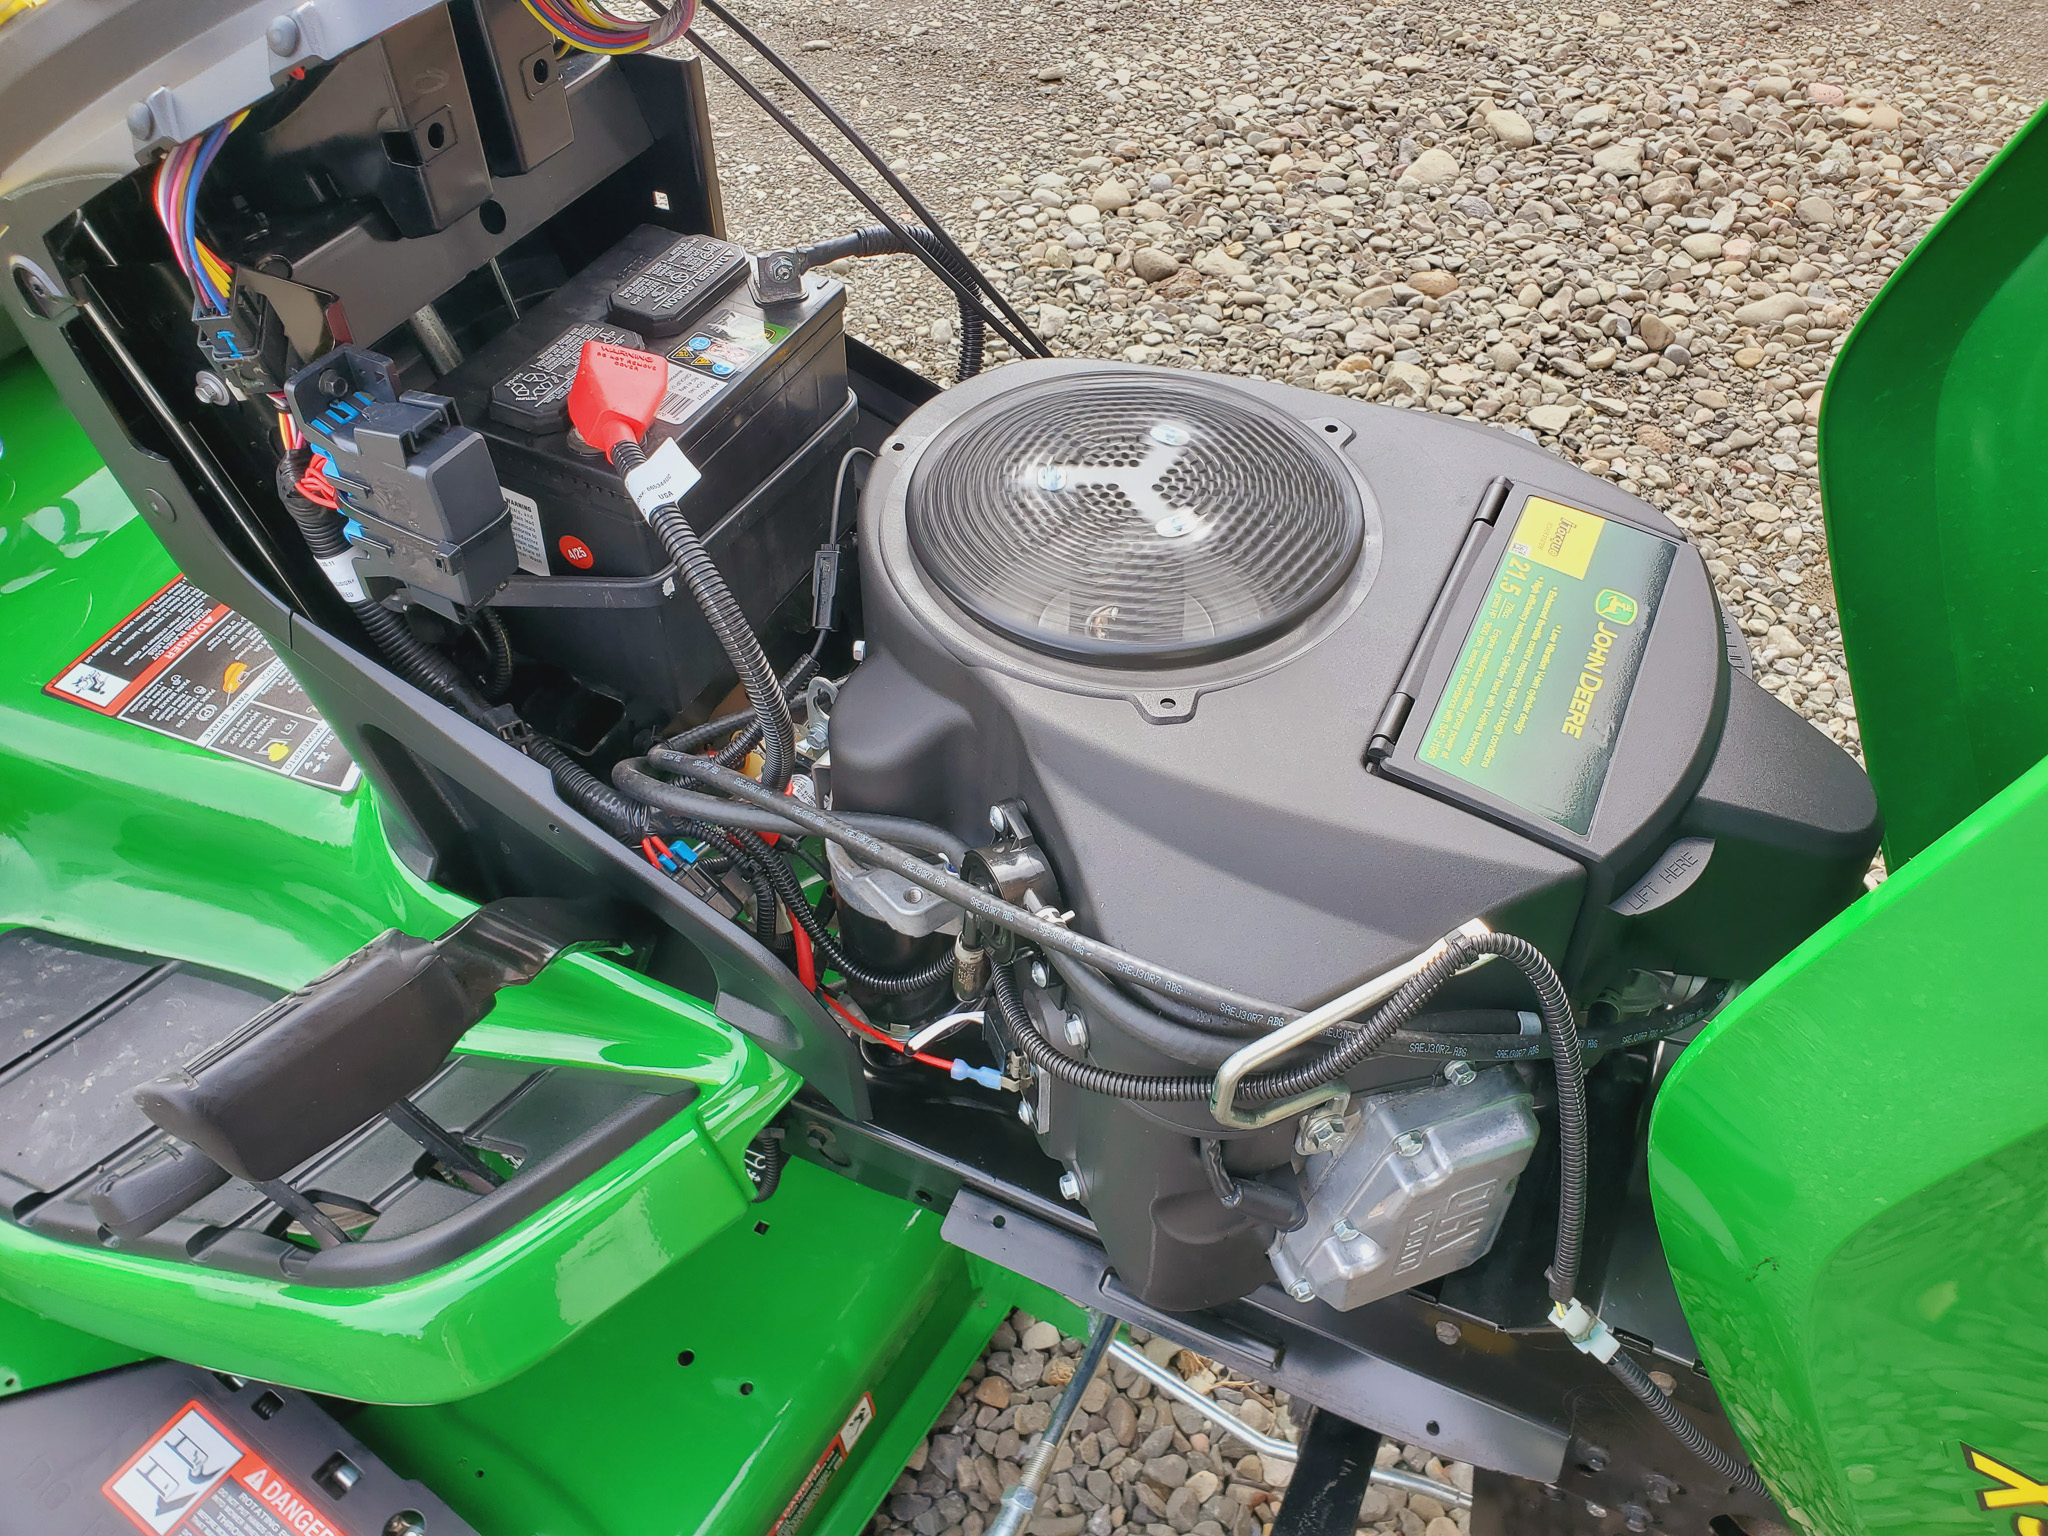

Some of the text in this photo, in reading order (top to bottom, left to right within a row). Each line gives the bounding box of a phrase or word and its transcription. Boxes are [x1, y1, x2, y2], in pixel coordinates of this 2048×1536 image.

[694, 256, 729, 281] DANGER
[660, 284, 694, 308] POISON
[599, 345, 654, 363] WARNING
[609, 354, 624, 362] NOT
[626, 359, 656, 371] REMOVE
[613, 361, 639, 371] COVER
[1543, 515, 1578, 560] iTorque
[567, 546, 588, 561] 4/25
[1497, 556, 1533, 597] 21.5
[1486, 591, 1503, 619] gross HP
[1500, 600, 1515, 620] 726cc
[1538, 589, 1557, 620] Enhanced
[146, 608, 204, 655] OFF ARMS AND LEGS
[184, 608, 213, 630] ROTATING
[161, 629, 188, 649] BLADES
[163, 622, 207, 660] DANGER
[1483, 626, 1503, 651] Engine
[1521, 639, 1538, 661] control
[150, 649, 165, 659] CUT
[1509, 658, 1530, 689] responds
[1560, 620, 1620, 741] JOHN DEERE
[147, 678, 190, 719] PARK BRAKE OFF
[1489, 677, 1504, 696] head
[1500, 685, 1520, 711] quickly
[174, 687, 216, 728] PARK BRAKE ON
[1483, 693, 1497, 709] with
[1500, 708, 1511, 718] to
[202, 692, 249, 738] PARK BRAKE
[228, 710, 260, 744] MOWER OFF
[1490, 714, 1508, 736] tough
[1510, 710, 1529, 736] design
[245, 716, 277, 749] MOWER ON
[319, 734, 334, 748] REV
[1434, 721, 1449, 739] SAE
[283, 727, 324, 769] MOWER/PTO
[1457, 729, 1483, 768] technology
[1479, 733, 1501, 770] conditions
[1625, 852, 1698, 910] LIFT HERE
[1116, 961, 1161, 985] SAEJ30R7
[1219, 1002, 1264, 1024] SAEJ30R7
[237, 1491, 281, 1533] ROTATING
